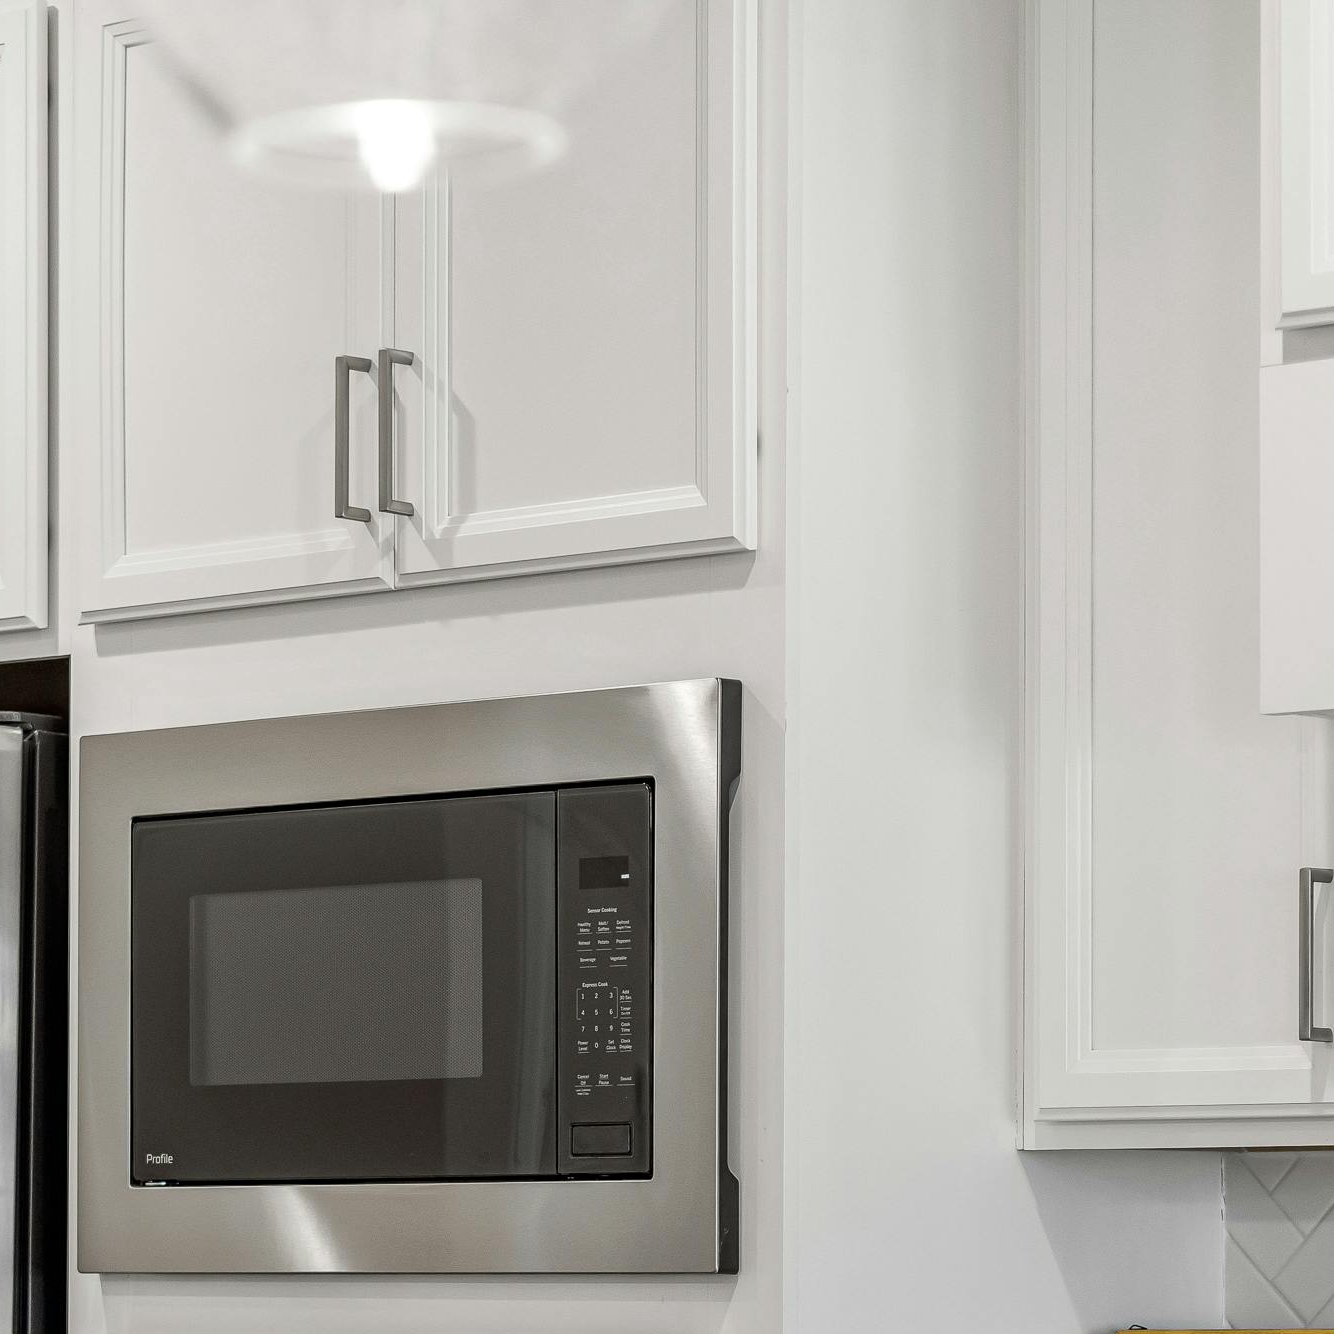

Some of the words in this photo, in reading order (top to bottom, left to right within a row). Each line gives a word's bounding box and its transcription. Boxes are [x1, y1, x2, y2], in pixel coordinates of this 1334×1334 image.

[609, 991, 614, 999] 3
[594, 1008, 599, 1016] 5
[594, 1041, 599, 1049] 0
[146, 1153, 174, 1164] Profile
